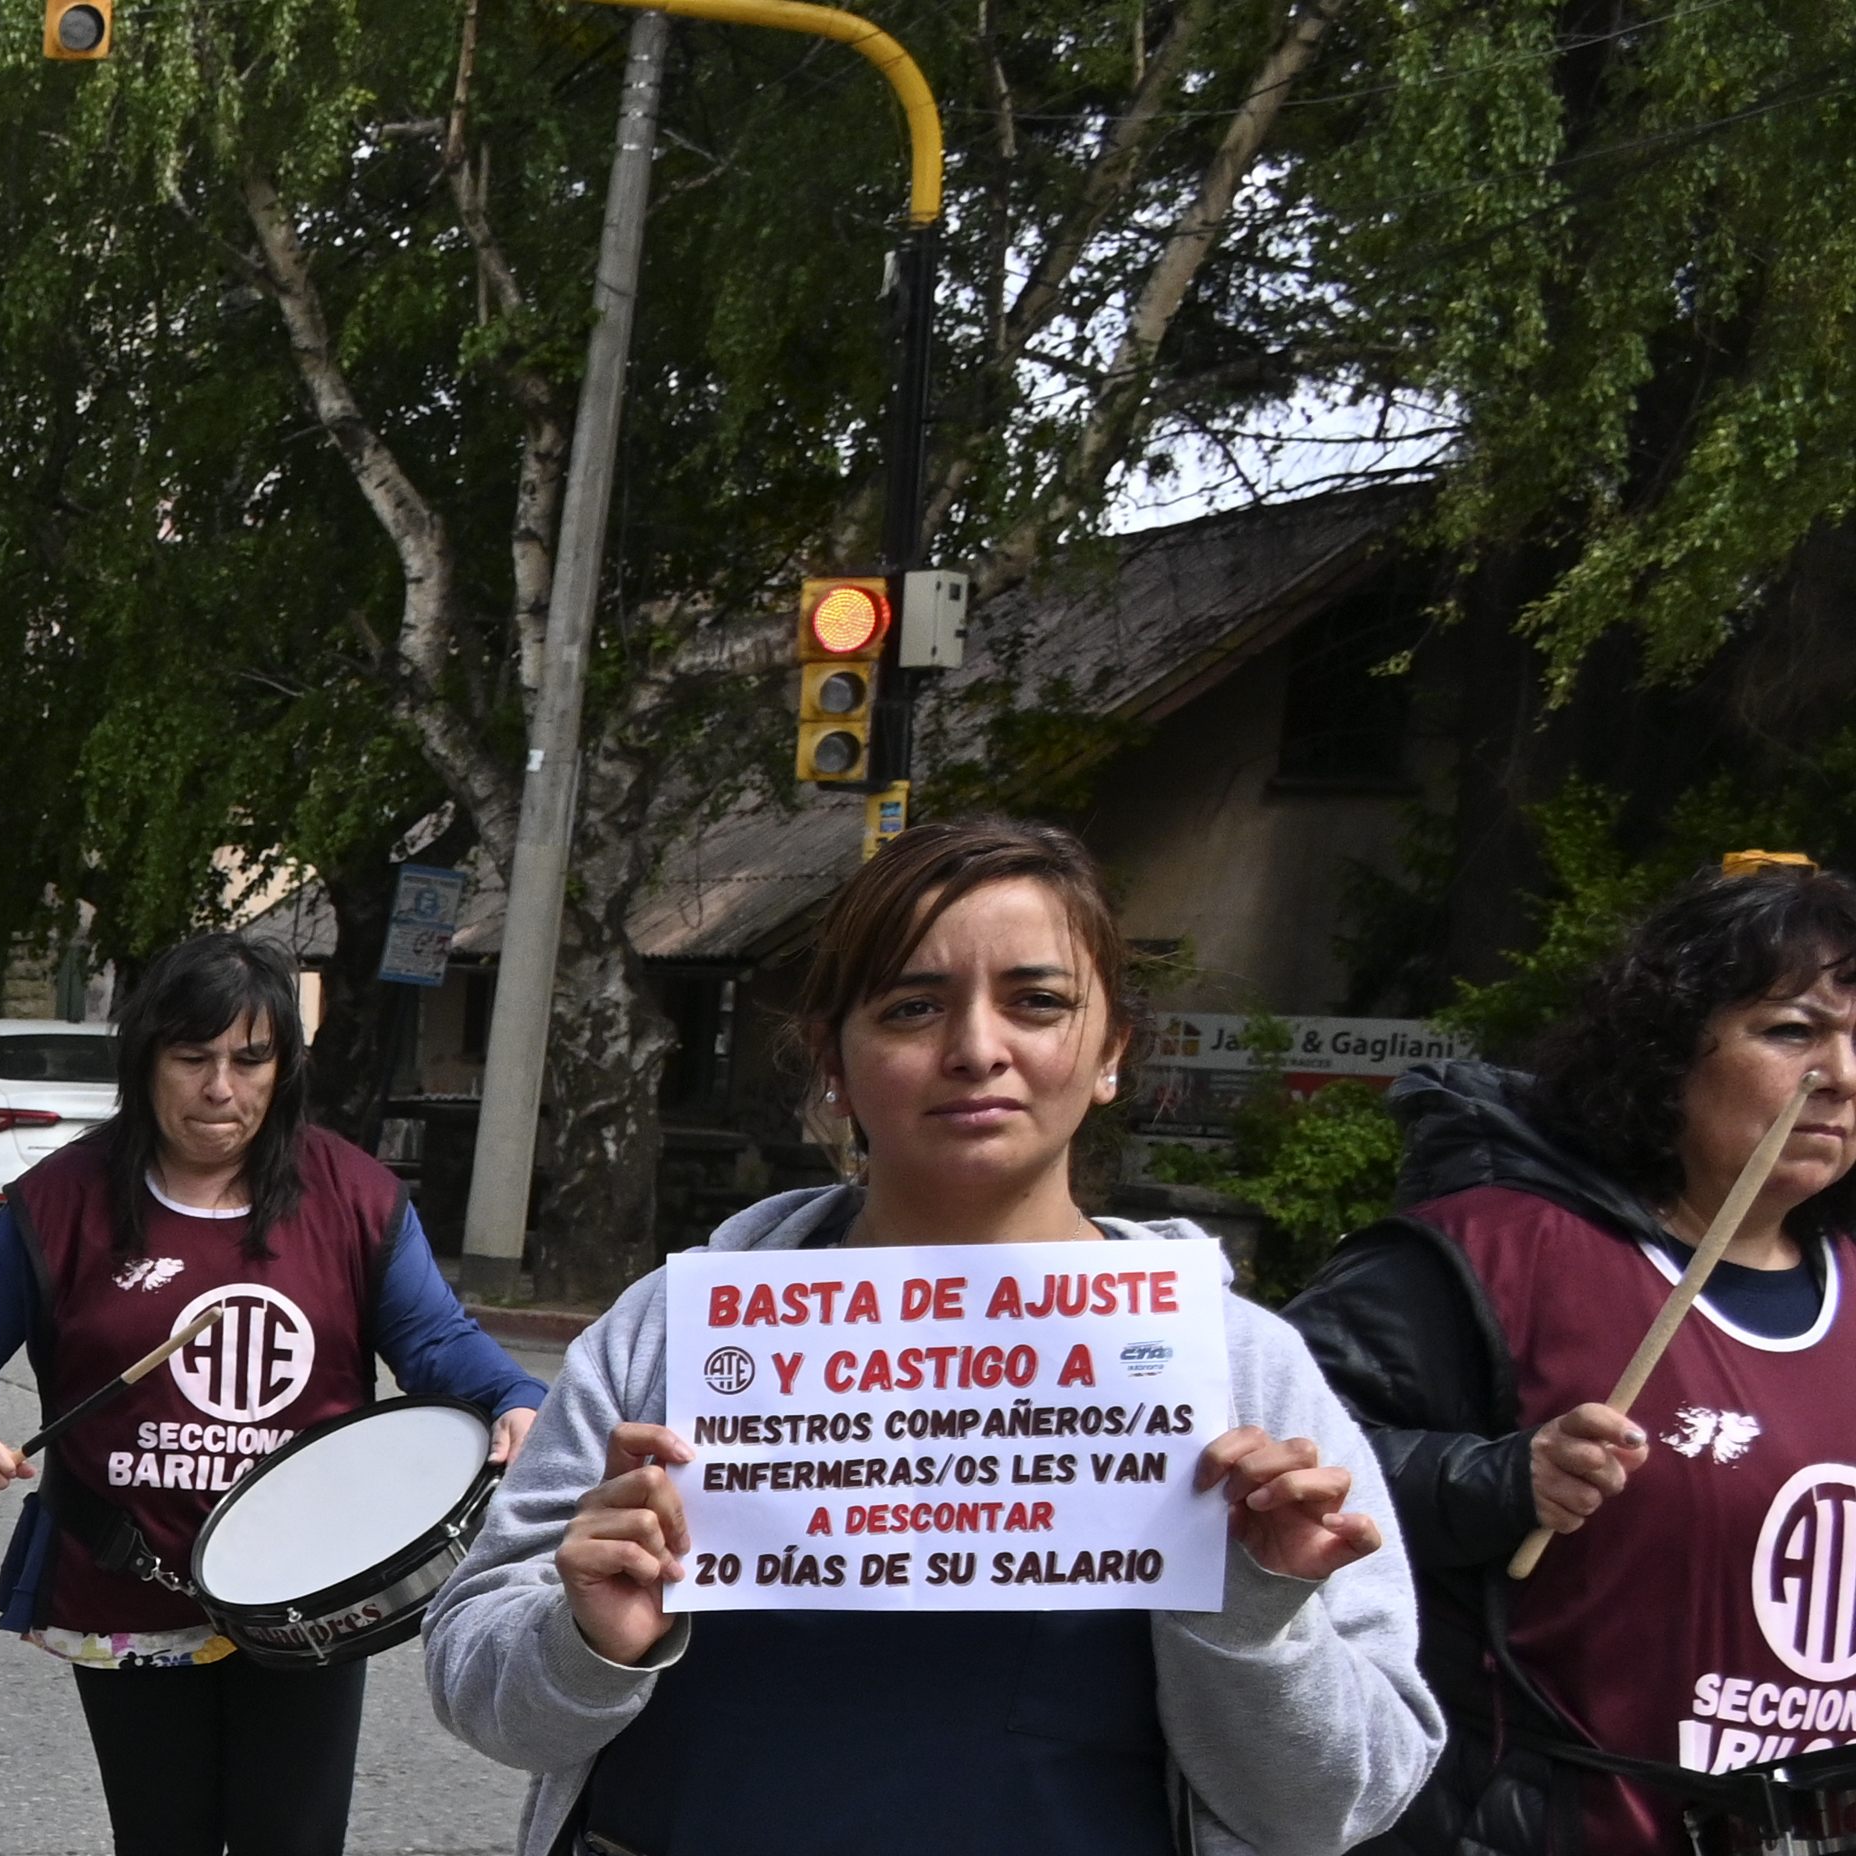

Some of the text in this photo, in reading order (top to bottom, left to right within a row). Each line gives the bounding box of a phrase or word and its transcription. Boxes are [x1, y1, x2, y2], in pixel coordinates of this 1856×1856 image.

[1302, 1029, 1323, 1054] &
[1331, 1031, 1455, 1063] Gagliani
[708, 1271, 1178, 1328] BASTA DE AJUSTE
[772, 1344, 1095, 1394] Y CASTIGO A
[694, 1398, 1192, 1445] NUESTROS COMPAÑEROS/AS
[703, 1453, 1167, 1493] ENFERMERAS/OS LES VAN
[806, 1502, 1054, 1536] A DESCONTAR
[695, 1545, 1164, 1587] 20 DÍAS DE SU SALARIO
